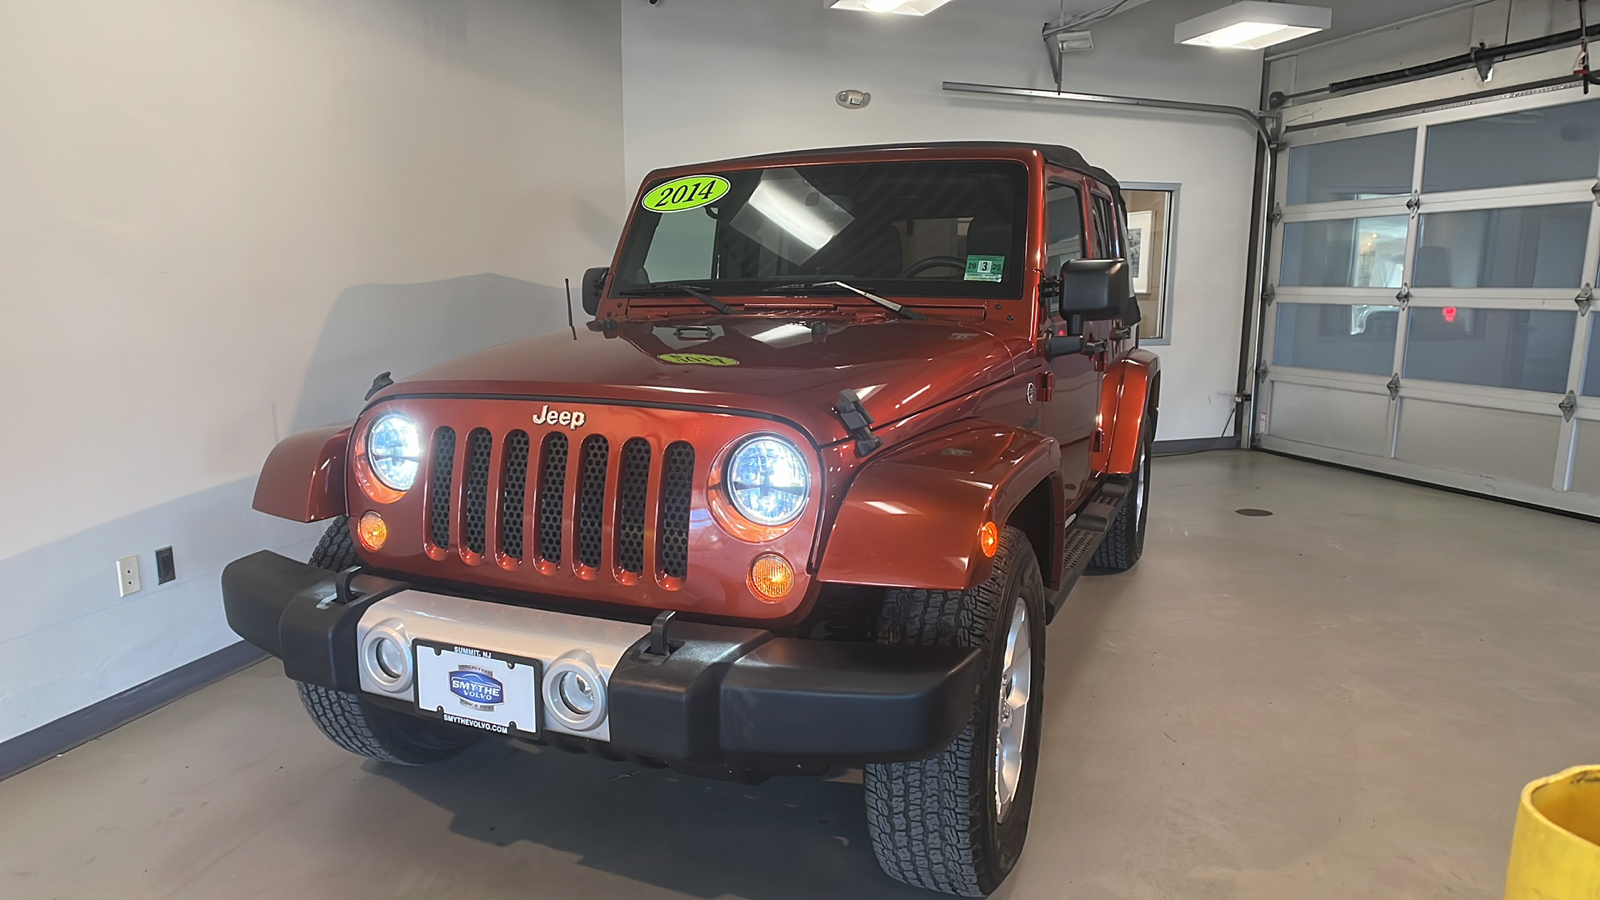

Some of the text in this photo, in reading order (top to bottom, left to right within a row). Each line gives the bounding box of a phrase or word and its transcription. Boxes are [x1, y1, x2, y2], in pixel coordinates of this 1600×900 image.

[654, 180, 717, 208] 2014
[968, 261, 1002, 272] 20 3 25
[532, 404, 586, 430] Jeep
[482, 651, 492, 659] NJ
[452, 680, 500, 696] SMYTHE
[463, 690, 493, 701] VOLVO
[443, 714, 508, 733] SMYTHEVOLVO.COM
